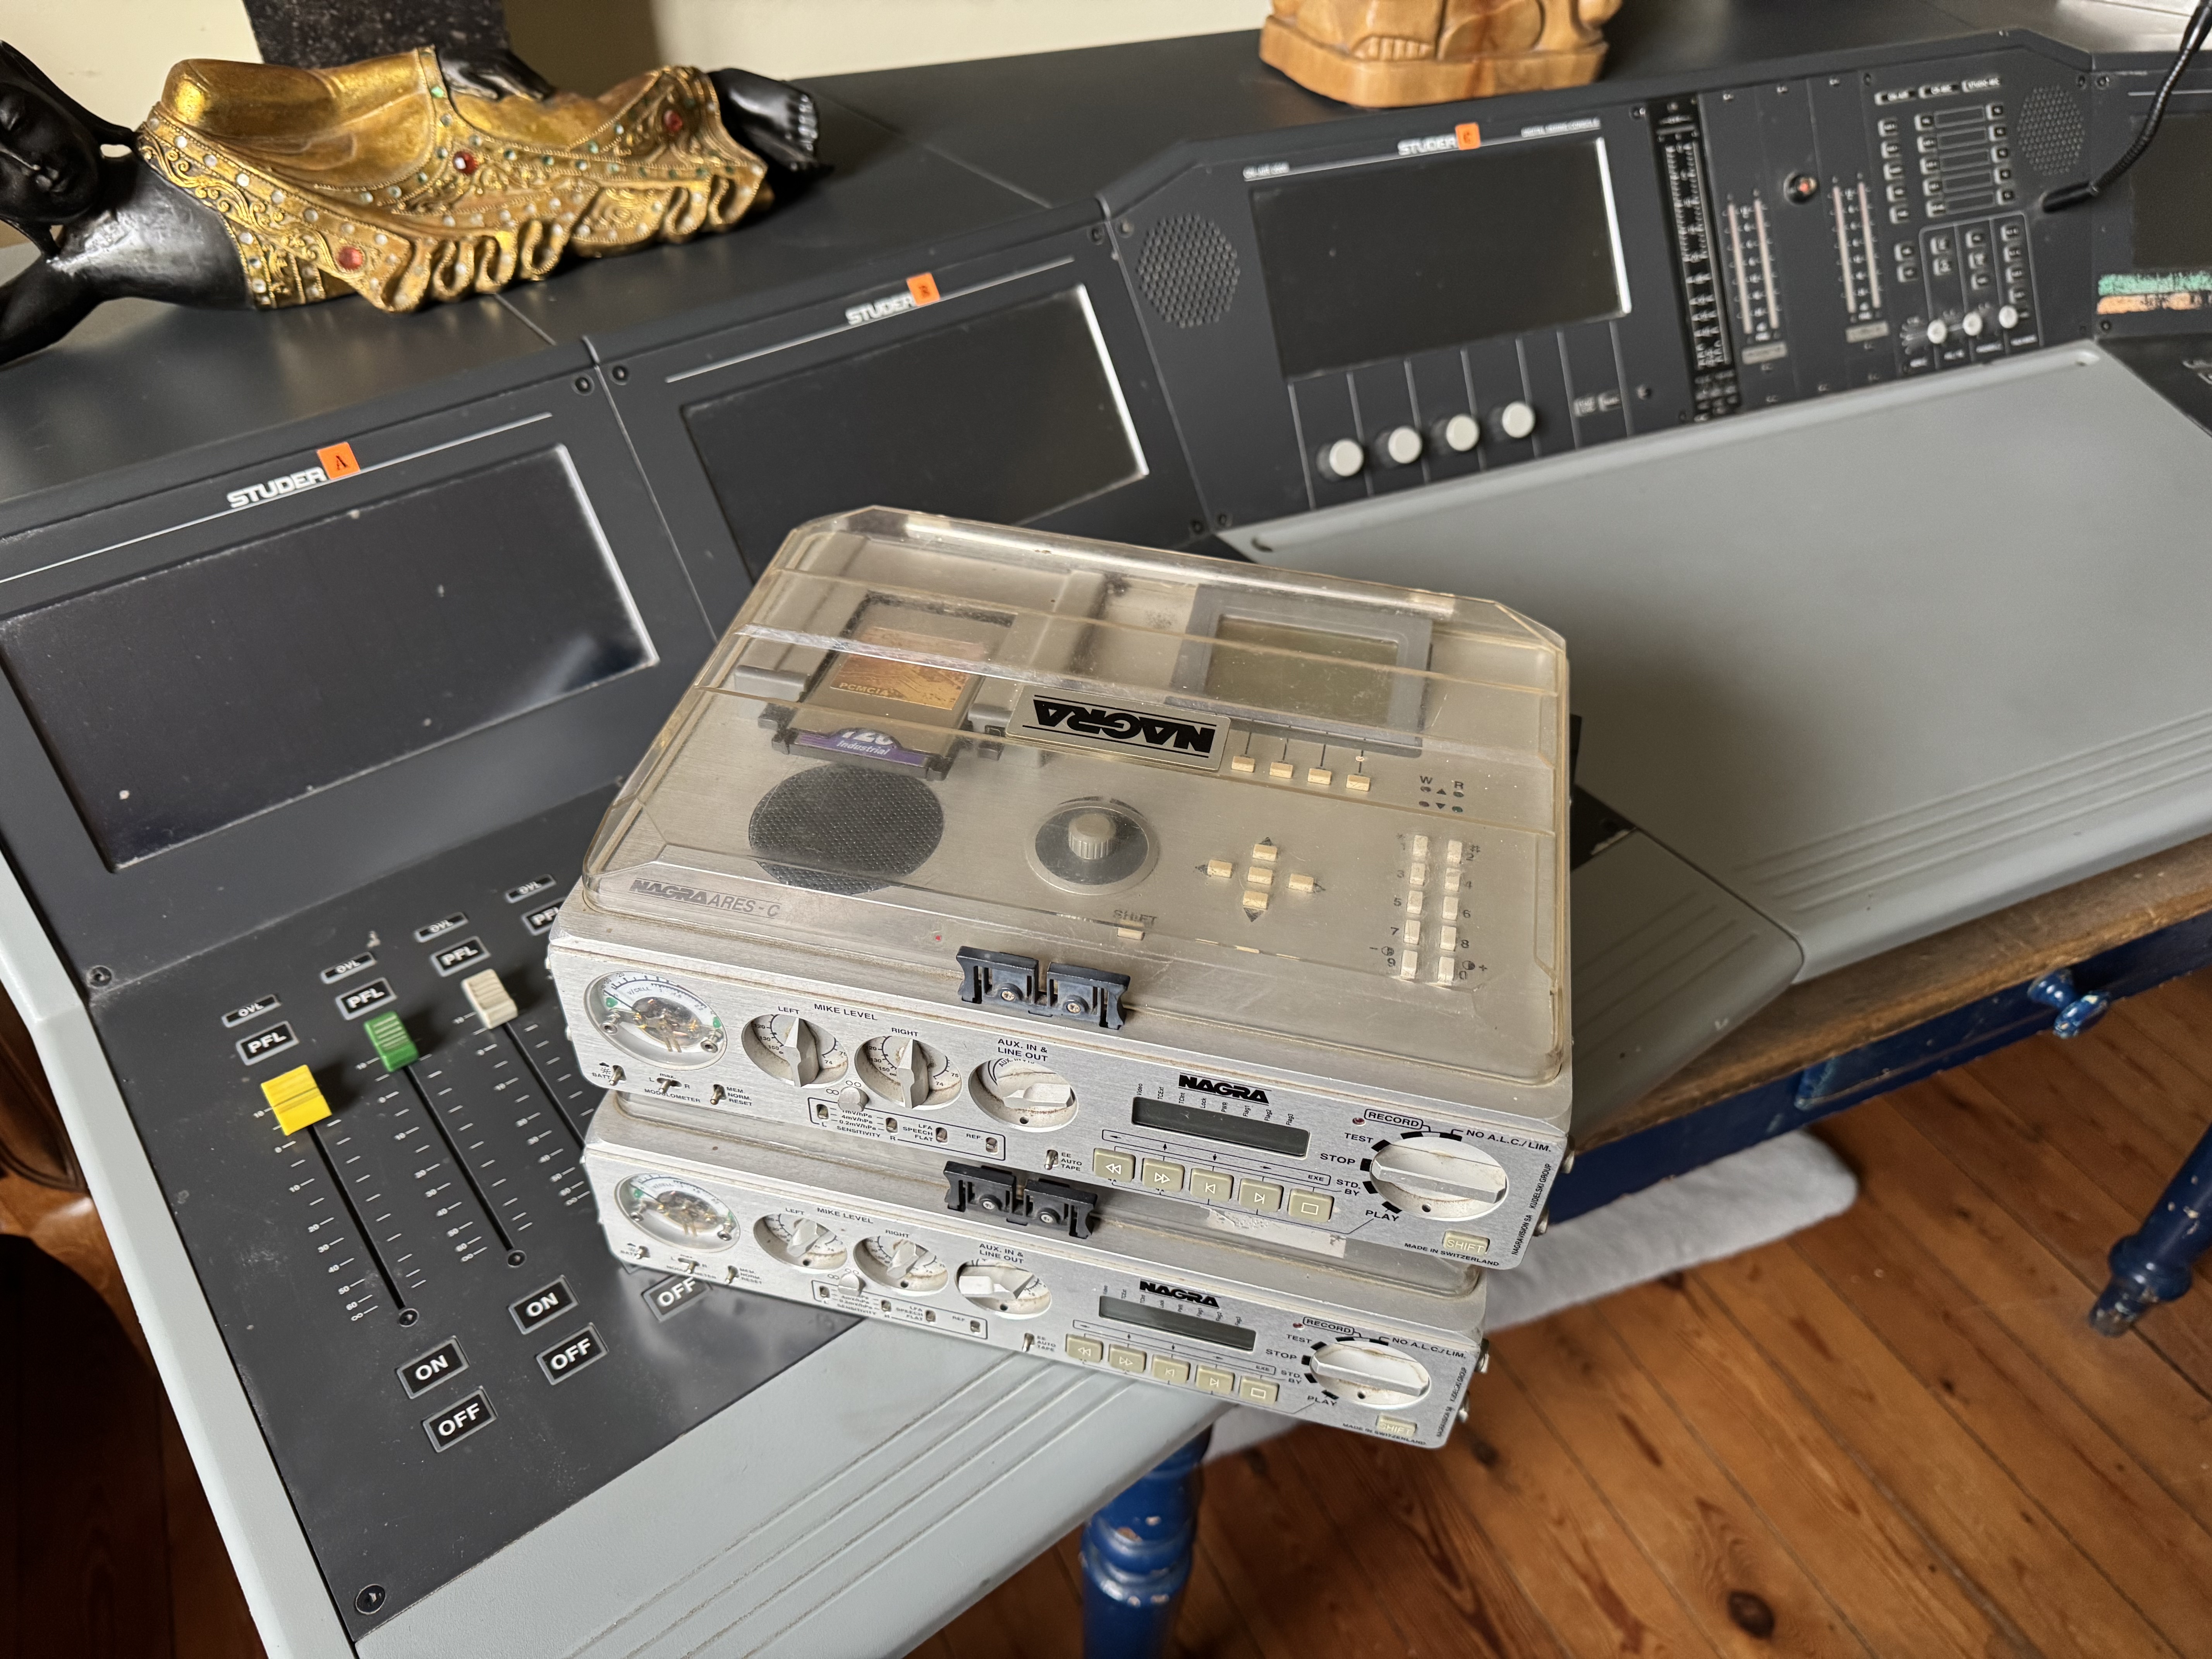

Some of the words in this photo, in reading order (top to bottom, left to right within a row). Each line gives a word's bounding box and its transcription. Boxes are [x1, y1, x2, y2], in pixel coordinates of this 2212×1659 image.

[1398, 134, 1457, 155] STUDER
[845, 292, 917, 325] STUDER
[336, 455, 348, 471] A
[227, 467, 327, 508] STUDER
[839, 683, 890, 696] PCMCIA
[1033, 699, 1215, 754] NAGRA
[836, 740, 891, 755] Industrial
[1420, 776, 1433, 784] W
[1454, 781, 1464, 789] R
[1397, 870, 1405, 878] 3
[517, 881, 543, 895] OVL
[1466, 881, 1472, 889] 4
[629, 879, 707, 905] NAGRA
[1393, 898, 1402, 907] 5
[1463, 910, 1471, 919] 6
[428, 919, 453, 933] OVL
[1461, 940, 1469, 948] 8
[440, 946, 478, 966] PFL
[335, 960, 361, 974] OVL
[1388, 958, 1396, 967] 9
[1459, 970, 1468, 980] 0
[346, 988, 385, 1008] PFL
[239, 1003, 264, 1017] OVL
[778, 1006, 800, 1014] LEFT
[814, 1003, 841, 1013] MIKE
[843, 1008, 878, 1020] LEVEL
[891, 1027, 919, 1037] RIGHT
[247, 1032, 287, 1054] PFL
[998, 1039, 1023, 1048] AUX.
[998, 1047, 1022, 1057] LINE
[1025, 1053, 1048, 1061] OUT
[1178, 1074, 1269, 1104] NAGRA
[728, 1092, 752, 1101] NORM.
[729, 1098, 753, 1106] RESET
[253, 1110, 264, 1118] 10
[842, 1115, 873, 1124] 4mV/hPa
[1264, 1109, 1273, 1121] Flag2
[1286, 1113, 1294, 1126] Flag3
[1368, 1111, 1419, 1127] RECORD
[839, 1120, 876, 1130] 0.2mV/hPa
[837, 1125, 880, 1138] SENSITIVITY
[903, 1127, 933, 1136] SPEECH
[1344, 1132, 1374, 1143] TEST
[1466, 1129, 1484, 1138] NO
[1320, 1153, 1356, 1165] STOP
[1061, 1164, 1081, 1172] TAPE
[289, 1184, 300, 1193] 10
[1336, 1179, 1361, 1189] STD.
[436, 1208, 448, 1217] 40
[817, 1207, 840, 1217] MIKE
[843, 1213, 873, 1224] LEVEL
[1511, 1223, 1530, 1256] NAGRAVISION
[1529, 1183, 1543, 1209] KUDELSKI
[1539, 1163, 1552, 1183] GROUP
[1365, 1210, 1400, 1222] PLAY
[308, 1224, 319, 1233] 20
[885, 1229, 910, 1238] RIGHT
[318, 1244, 330, 1253] 30
[979, 1243, 1002, 1253] AUX.
[1446, 1239, 1484, 1254] SHIFT
[980, 1250, 1001, 1259] LINE
[1004, 1255, 1024, 1264] OUT
[1404, 1243, 1428, 1252] MADE
[1440, 1250, 1500, 1267] SWITZERLAND
[328, 1264, 340, 1273] 40
[338, 1285, 350, 1295] 50
[658, 1277, 697, 1308] OFF
[1139, 1280, 1220, 1308] NAGRA
[346, 1301, 358, 1310] 60
[526, 1292, 559, 1317] ON
[1306, 1319, 1352, 1334] RECORD
[1286, 1334, 1312, 1344] TEST
[550, 1338, 591, 1370] OFF
[1266, 1348, 1297, 1360] STOP
[415, 1355, 449, 1381] ON
[1281, 1370, 1302, 1379] STD.
[1307, 1395, 1338, 1406] PLAY
[438, 1403, 480, 1436] OFF
[1377, 1422, 1411, 1434] SHIFT
